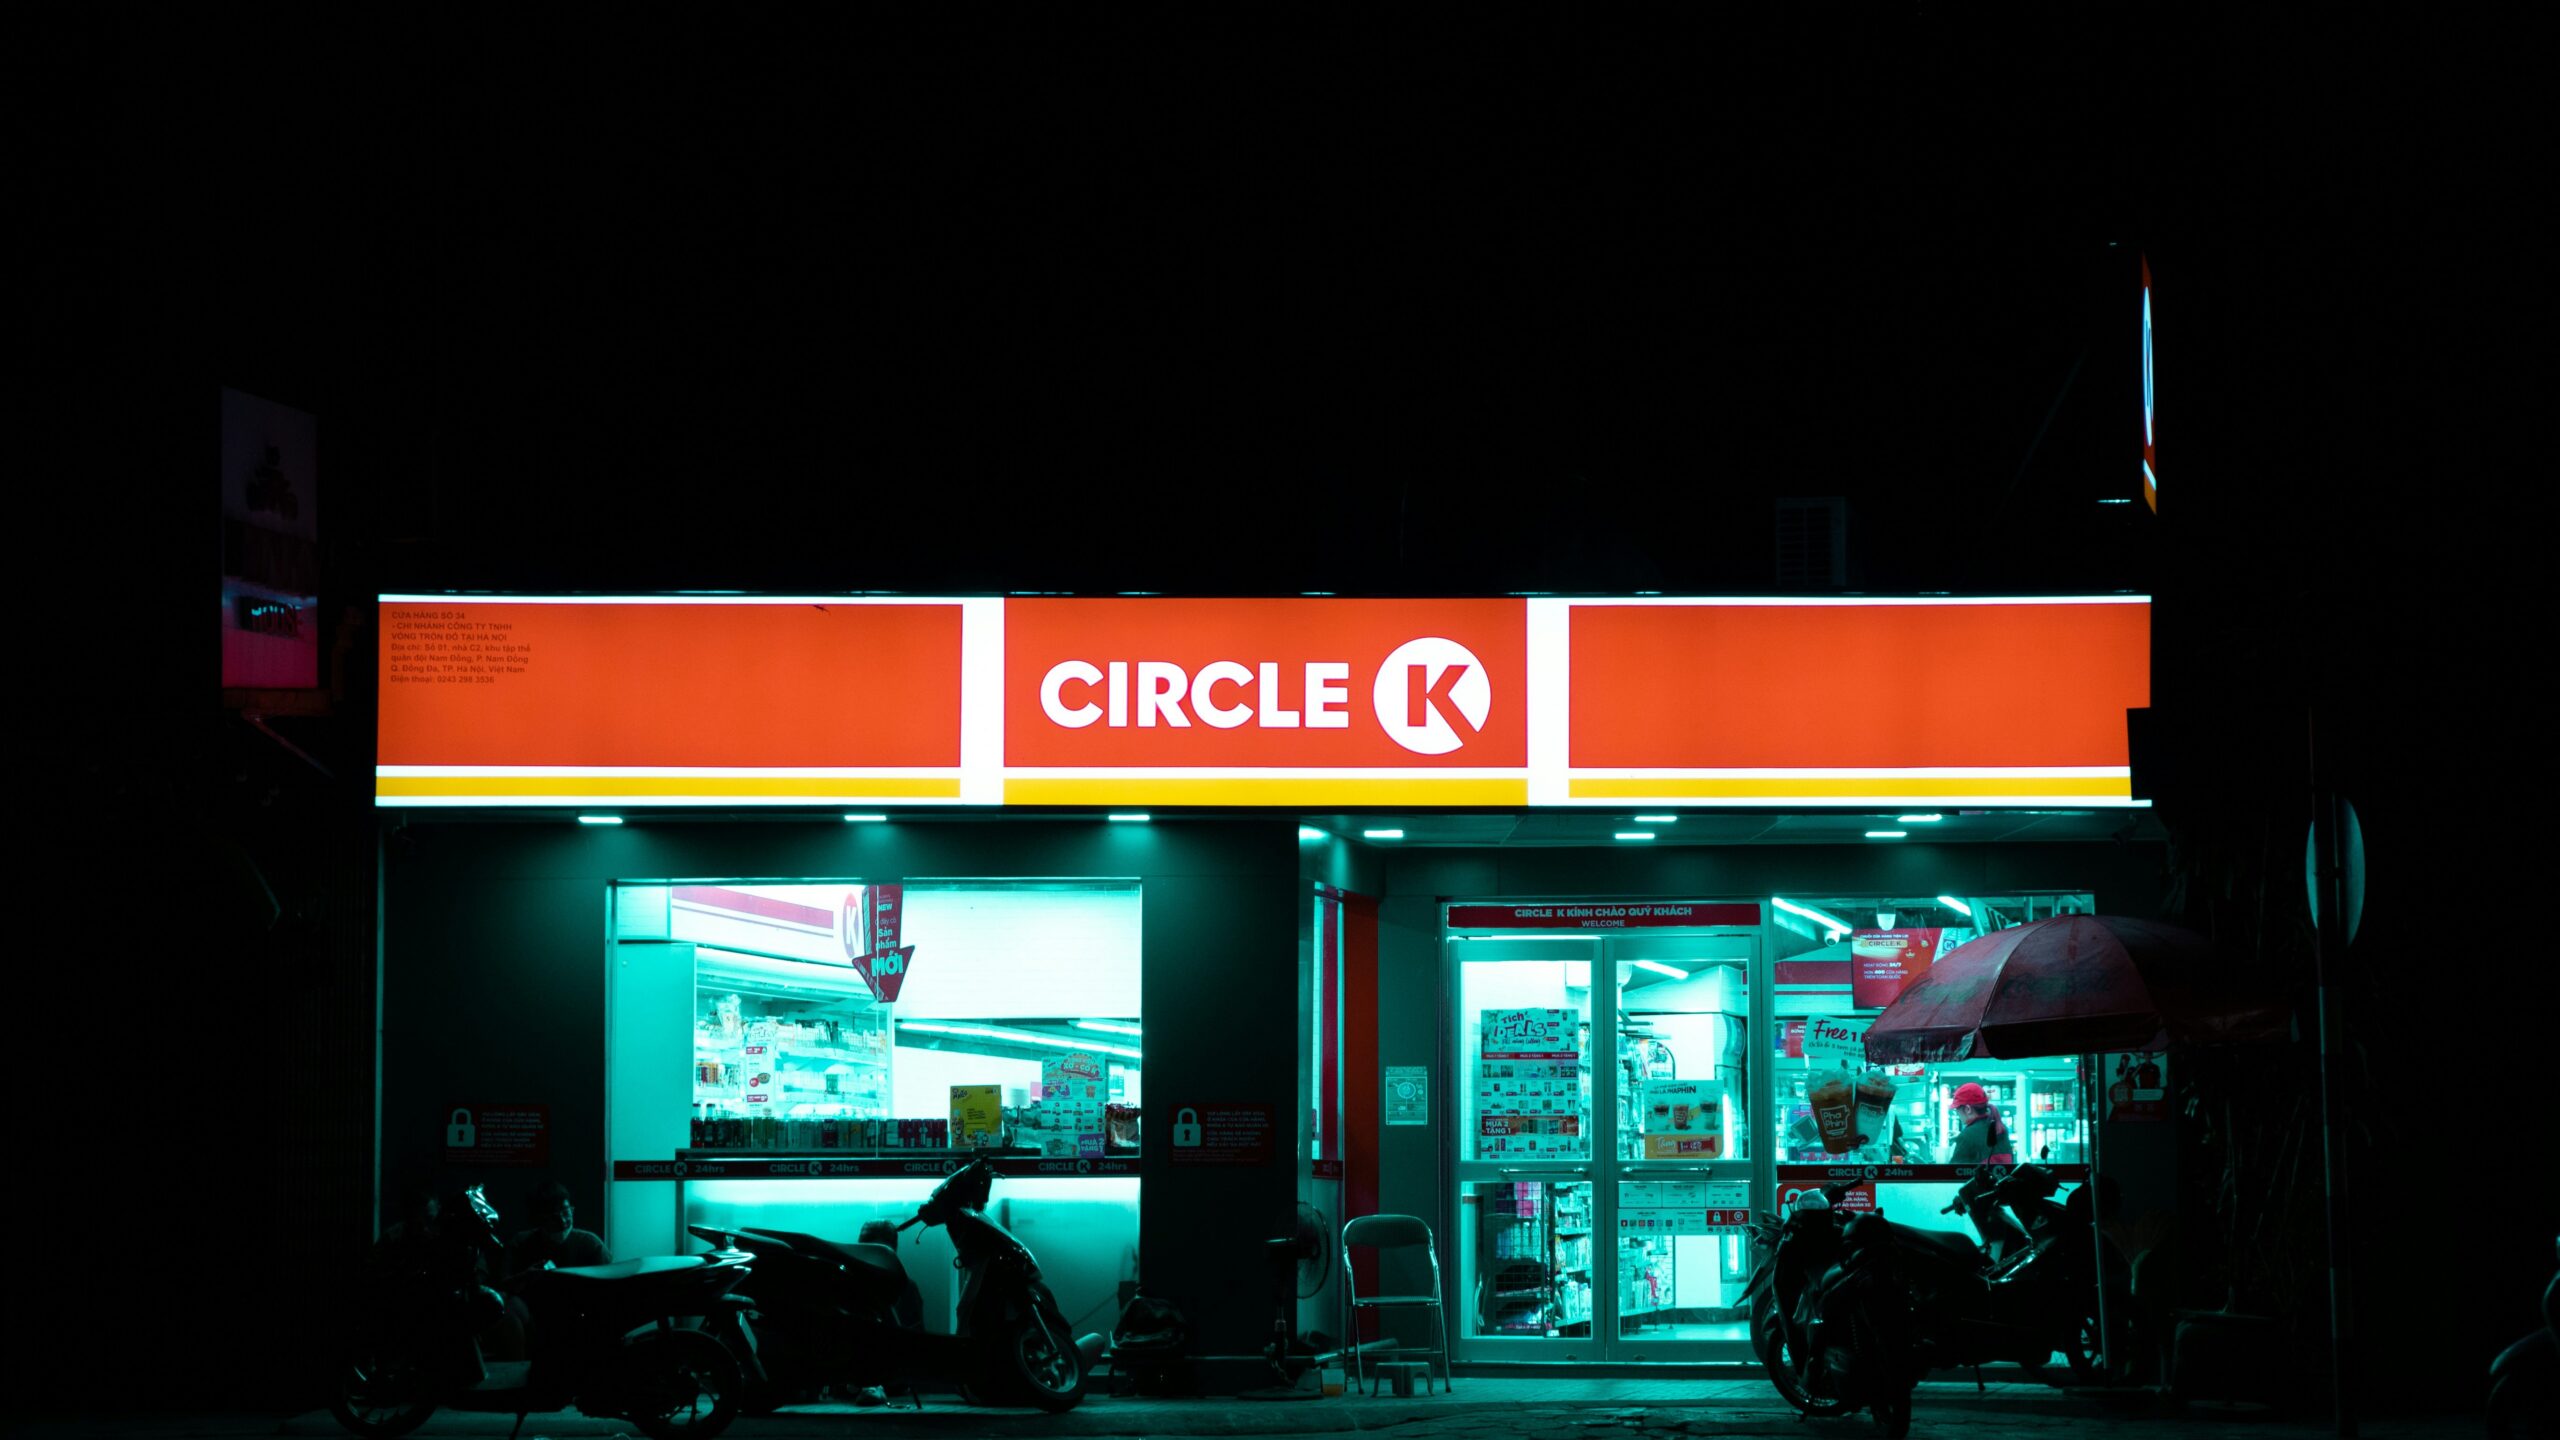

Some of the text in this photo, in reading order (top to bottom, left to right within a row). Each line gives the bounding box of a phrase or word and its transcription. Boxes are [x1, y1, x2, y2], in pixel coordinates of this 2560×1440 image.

[476, 622, 487, 631] TY
[488, 622, 512, 631] TNHH
[1040, 660, 1350, 729] CIRCLE
[1514, 905, 1692, 918] CIRCLE K KÍNH CHÀO QUÝ KHÁCH
[1581, 920, 1625, 928] WELCOME
[878, 927, 893, 937] Sản
[870, 950, 904, 977] MỚI
[1813, 1019, 1848, 1041] Free
[1851, 1031, 1857, 1042] 1
[1823, 1111, 1841, 1119] Pha
[635, 1164, 671, 1174] CIRCLE
[695, 1164, 725, 1174] 24hrs
[770, 1164, 806, 1174] CIRCLE
[830, 1164, 860, 1174] 24hrs
[904, 1162, 940, 1172] CIRCLE
[1038, 1162, 1074, 1172] CIRCLE
[1098, 1162, 1128, 1172] 24hrs
[1828, 1168, 1862, 1177] CIRCLE
[1885, 1168, 1914, 1177] 24hrs
